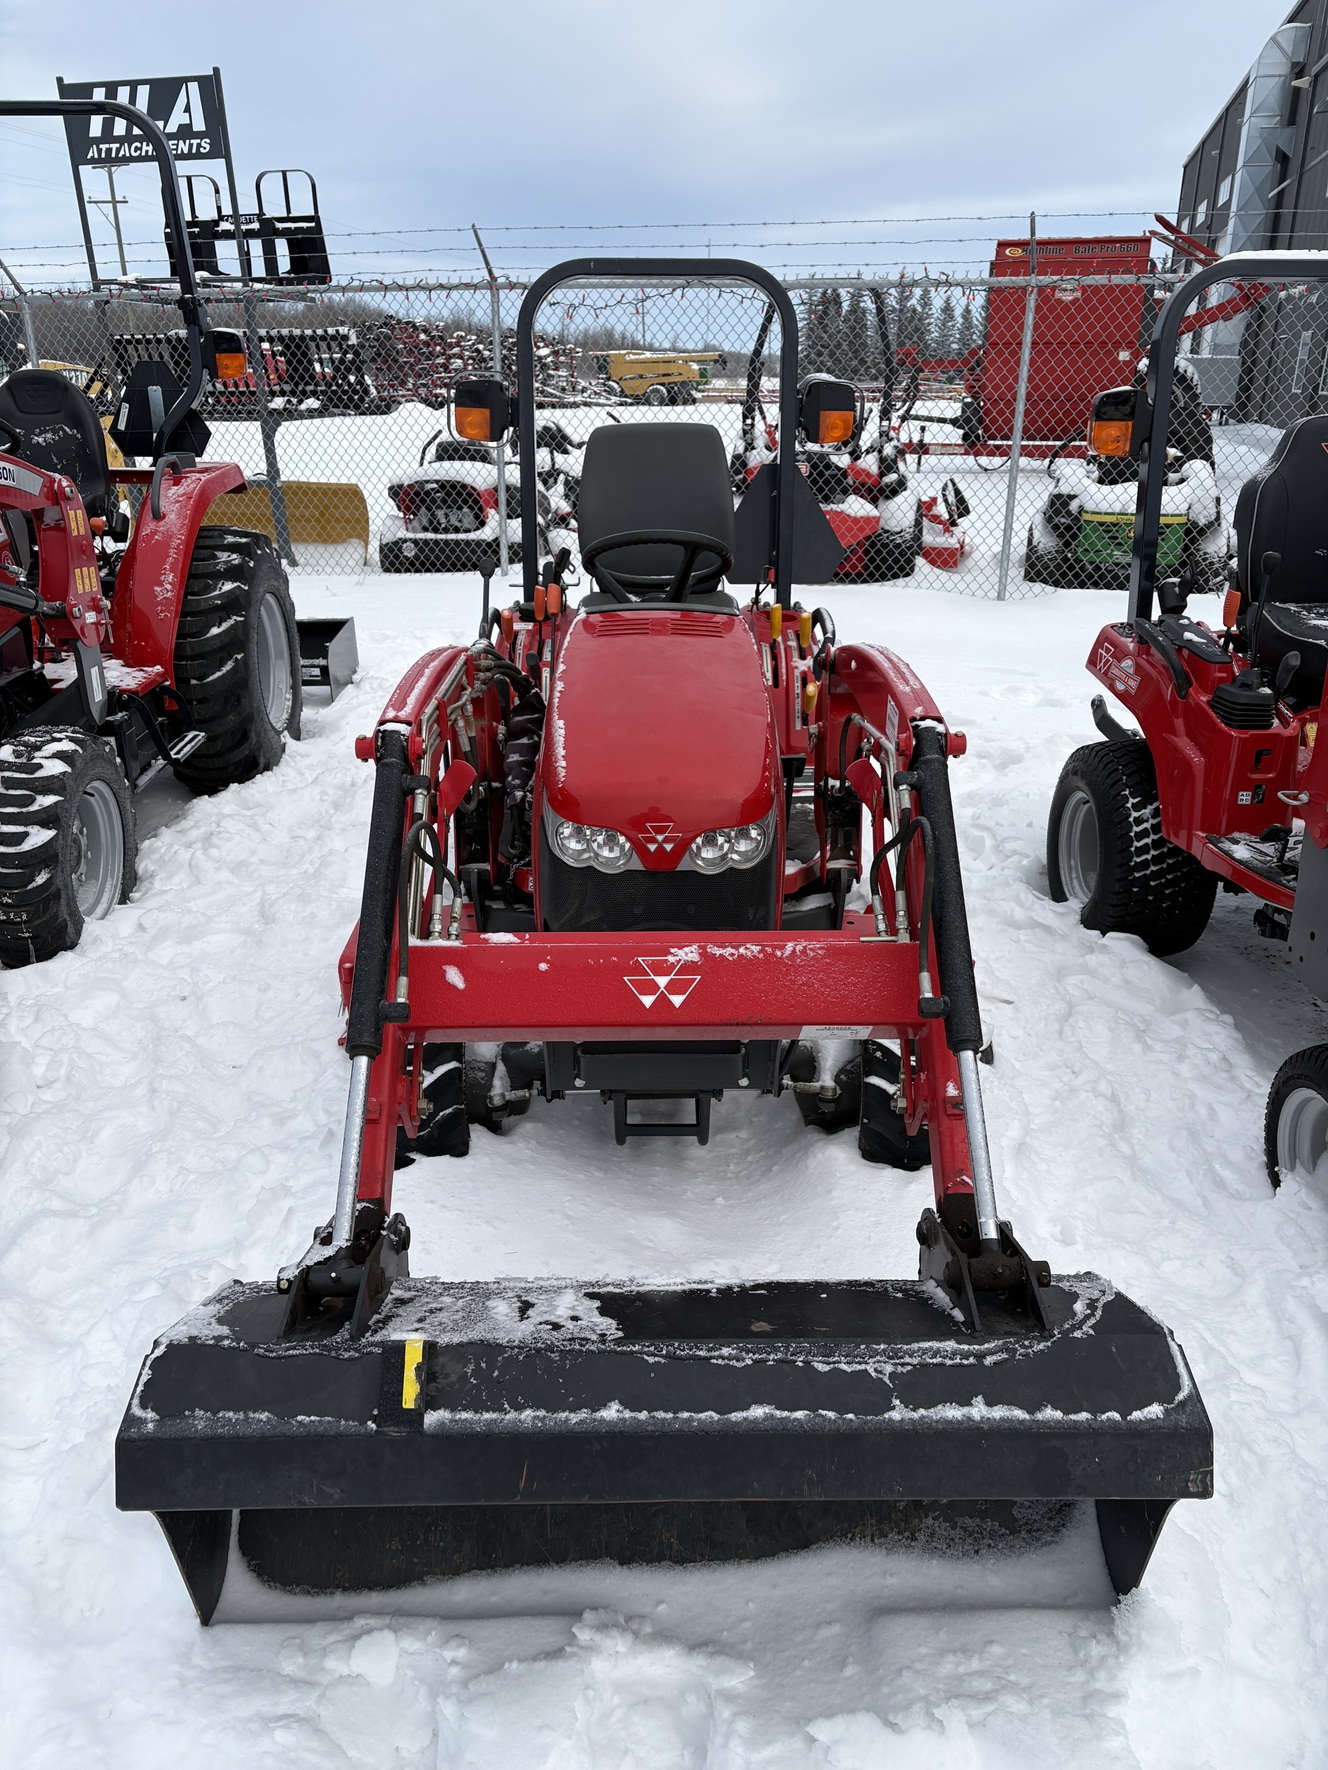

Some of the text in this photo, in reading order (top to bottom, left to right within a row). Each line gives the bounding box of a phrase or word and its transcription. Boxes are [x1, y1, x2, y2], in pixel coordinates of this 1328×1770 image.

[89, 81, 206, 137] HLA
[87, 138, 211, 159] ATTACHENTS
[223, 215, 259, 224] CAETTE
[1022, 243, 1139, 255] Hhline Bale Pro 660
